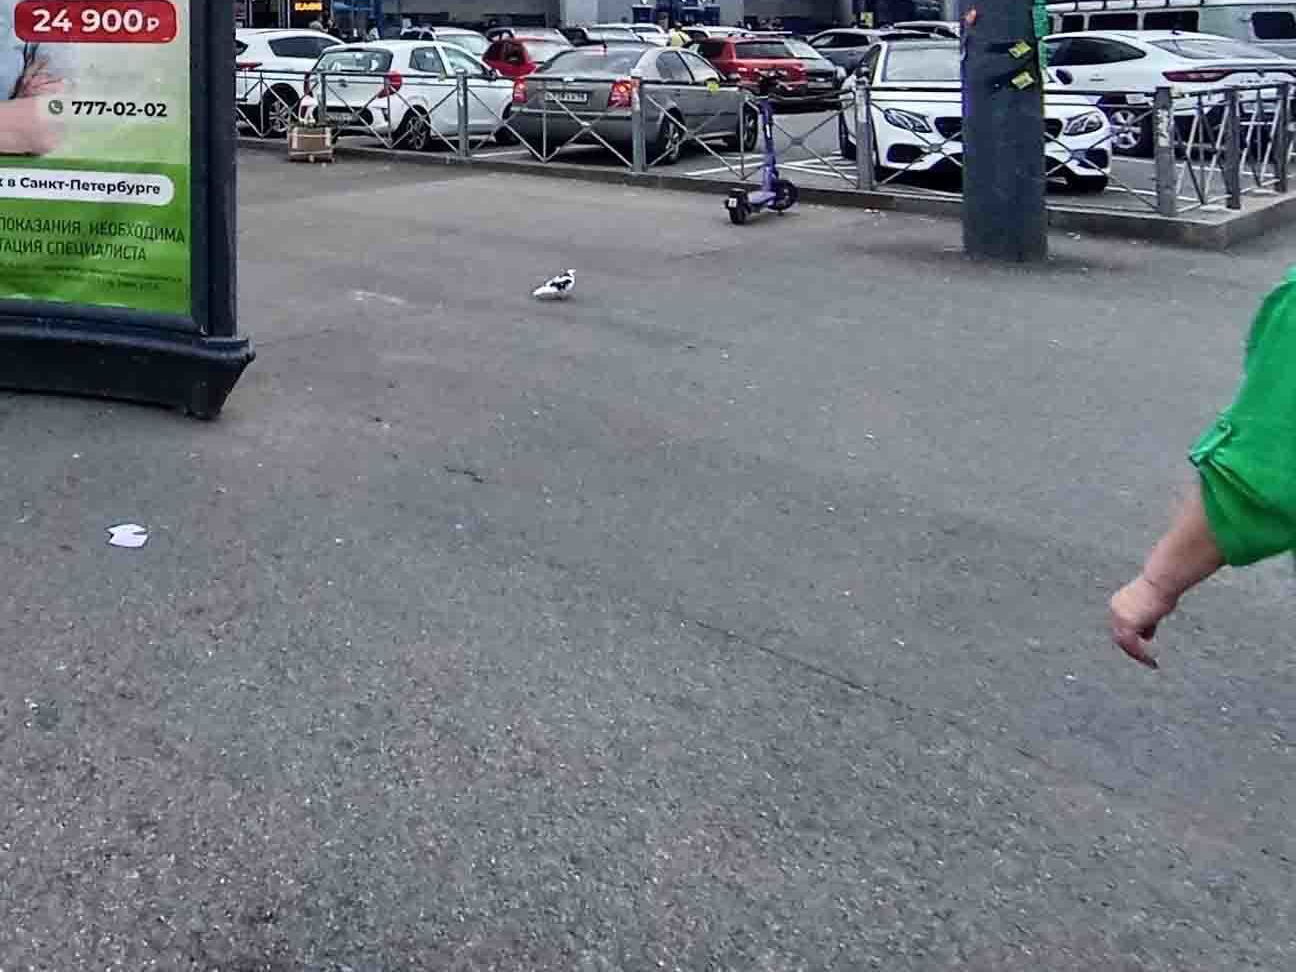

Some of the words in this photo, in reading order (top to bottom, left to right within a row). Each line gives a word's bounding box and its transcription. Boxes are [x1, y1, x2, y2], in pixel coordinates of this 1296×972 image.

[32, 8, 73, 33] 24
[71, 101, 168, 117] 777-02-02
[7, 179, 16, 189] в
[19, 177, 161, 196] Санкт-Петербурге
[88, 221, 185, 244] НЕОБХОДИМА
[47, 239, 147, 262] СПЕЦИАЛИСТА
